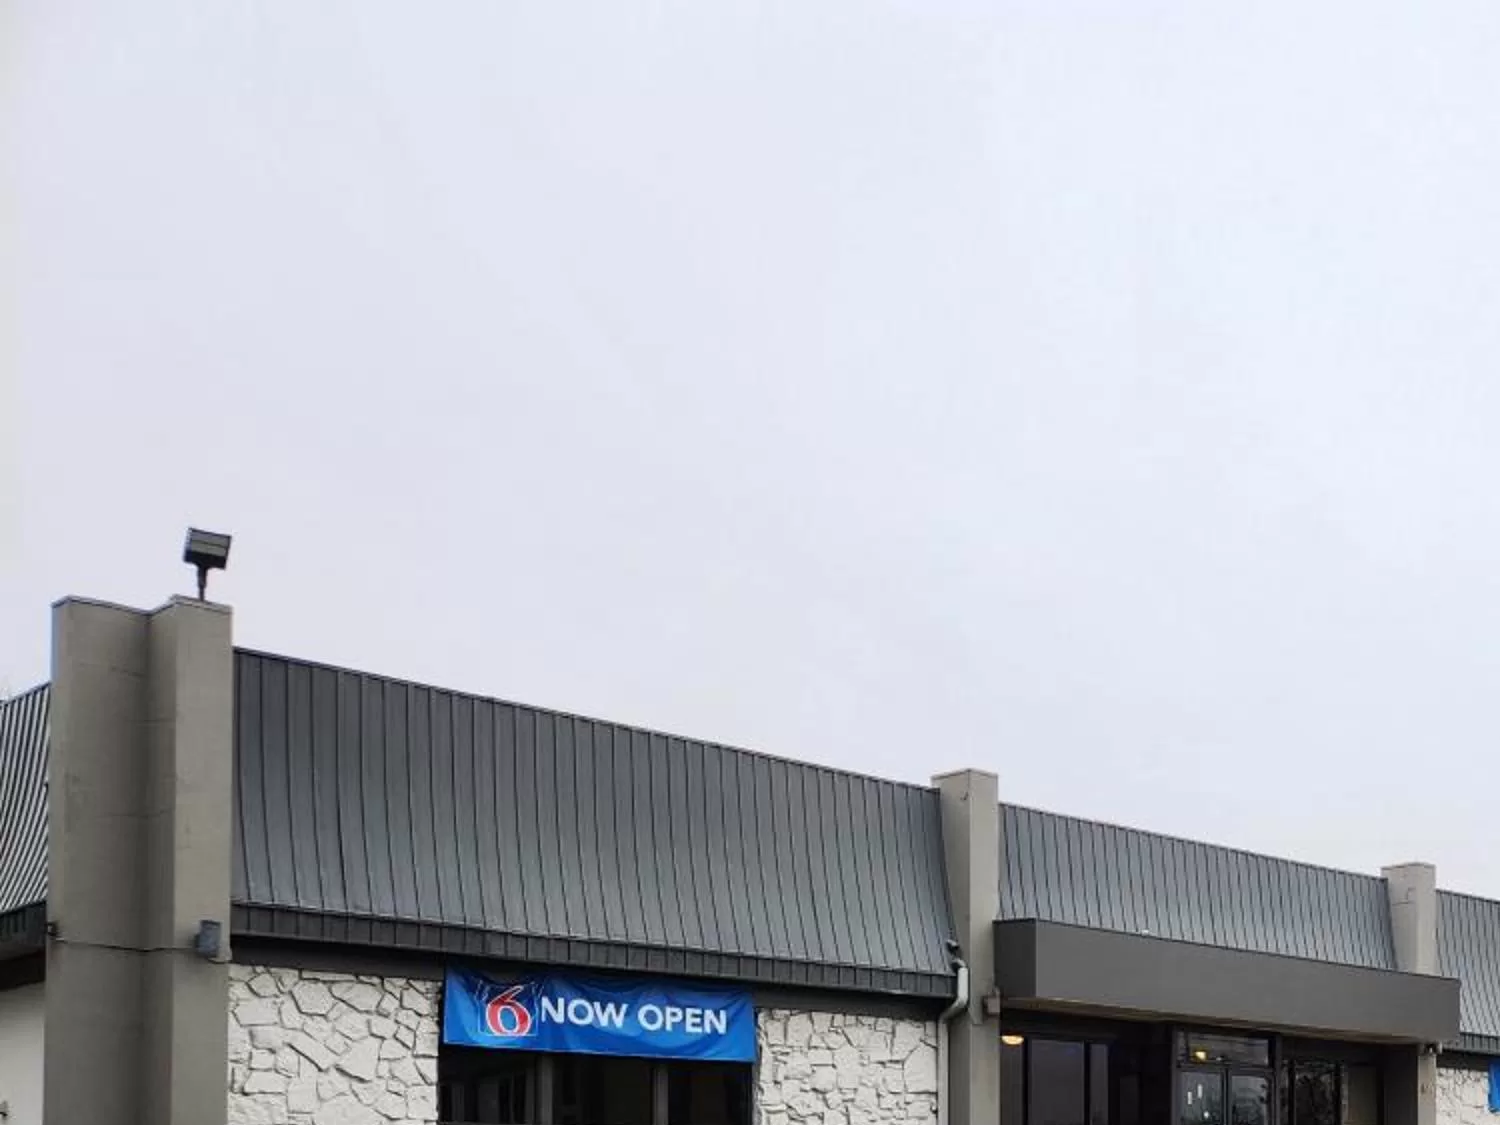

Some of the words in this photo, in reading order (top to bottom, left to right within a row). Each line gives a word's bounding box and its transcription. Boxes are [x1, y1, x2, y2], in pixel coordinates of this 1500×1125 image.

[485, 985, 532, 1037] 6
[541, 996, 629, 1029] NOW
[637, 1004, 727, 1035] OPEN
